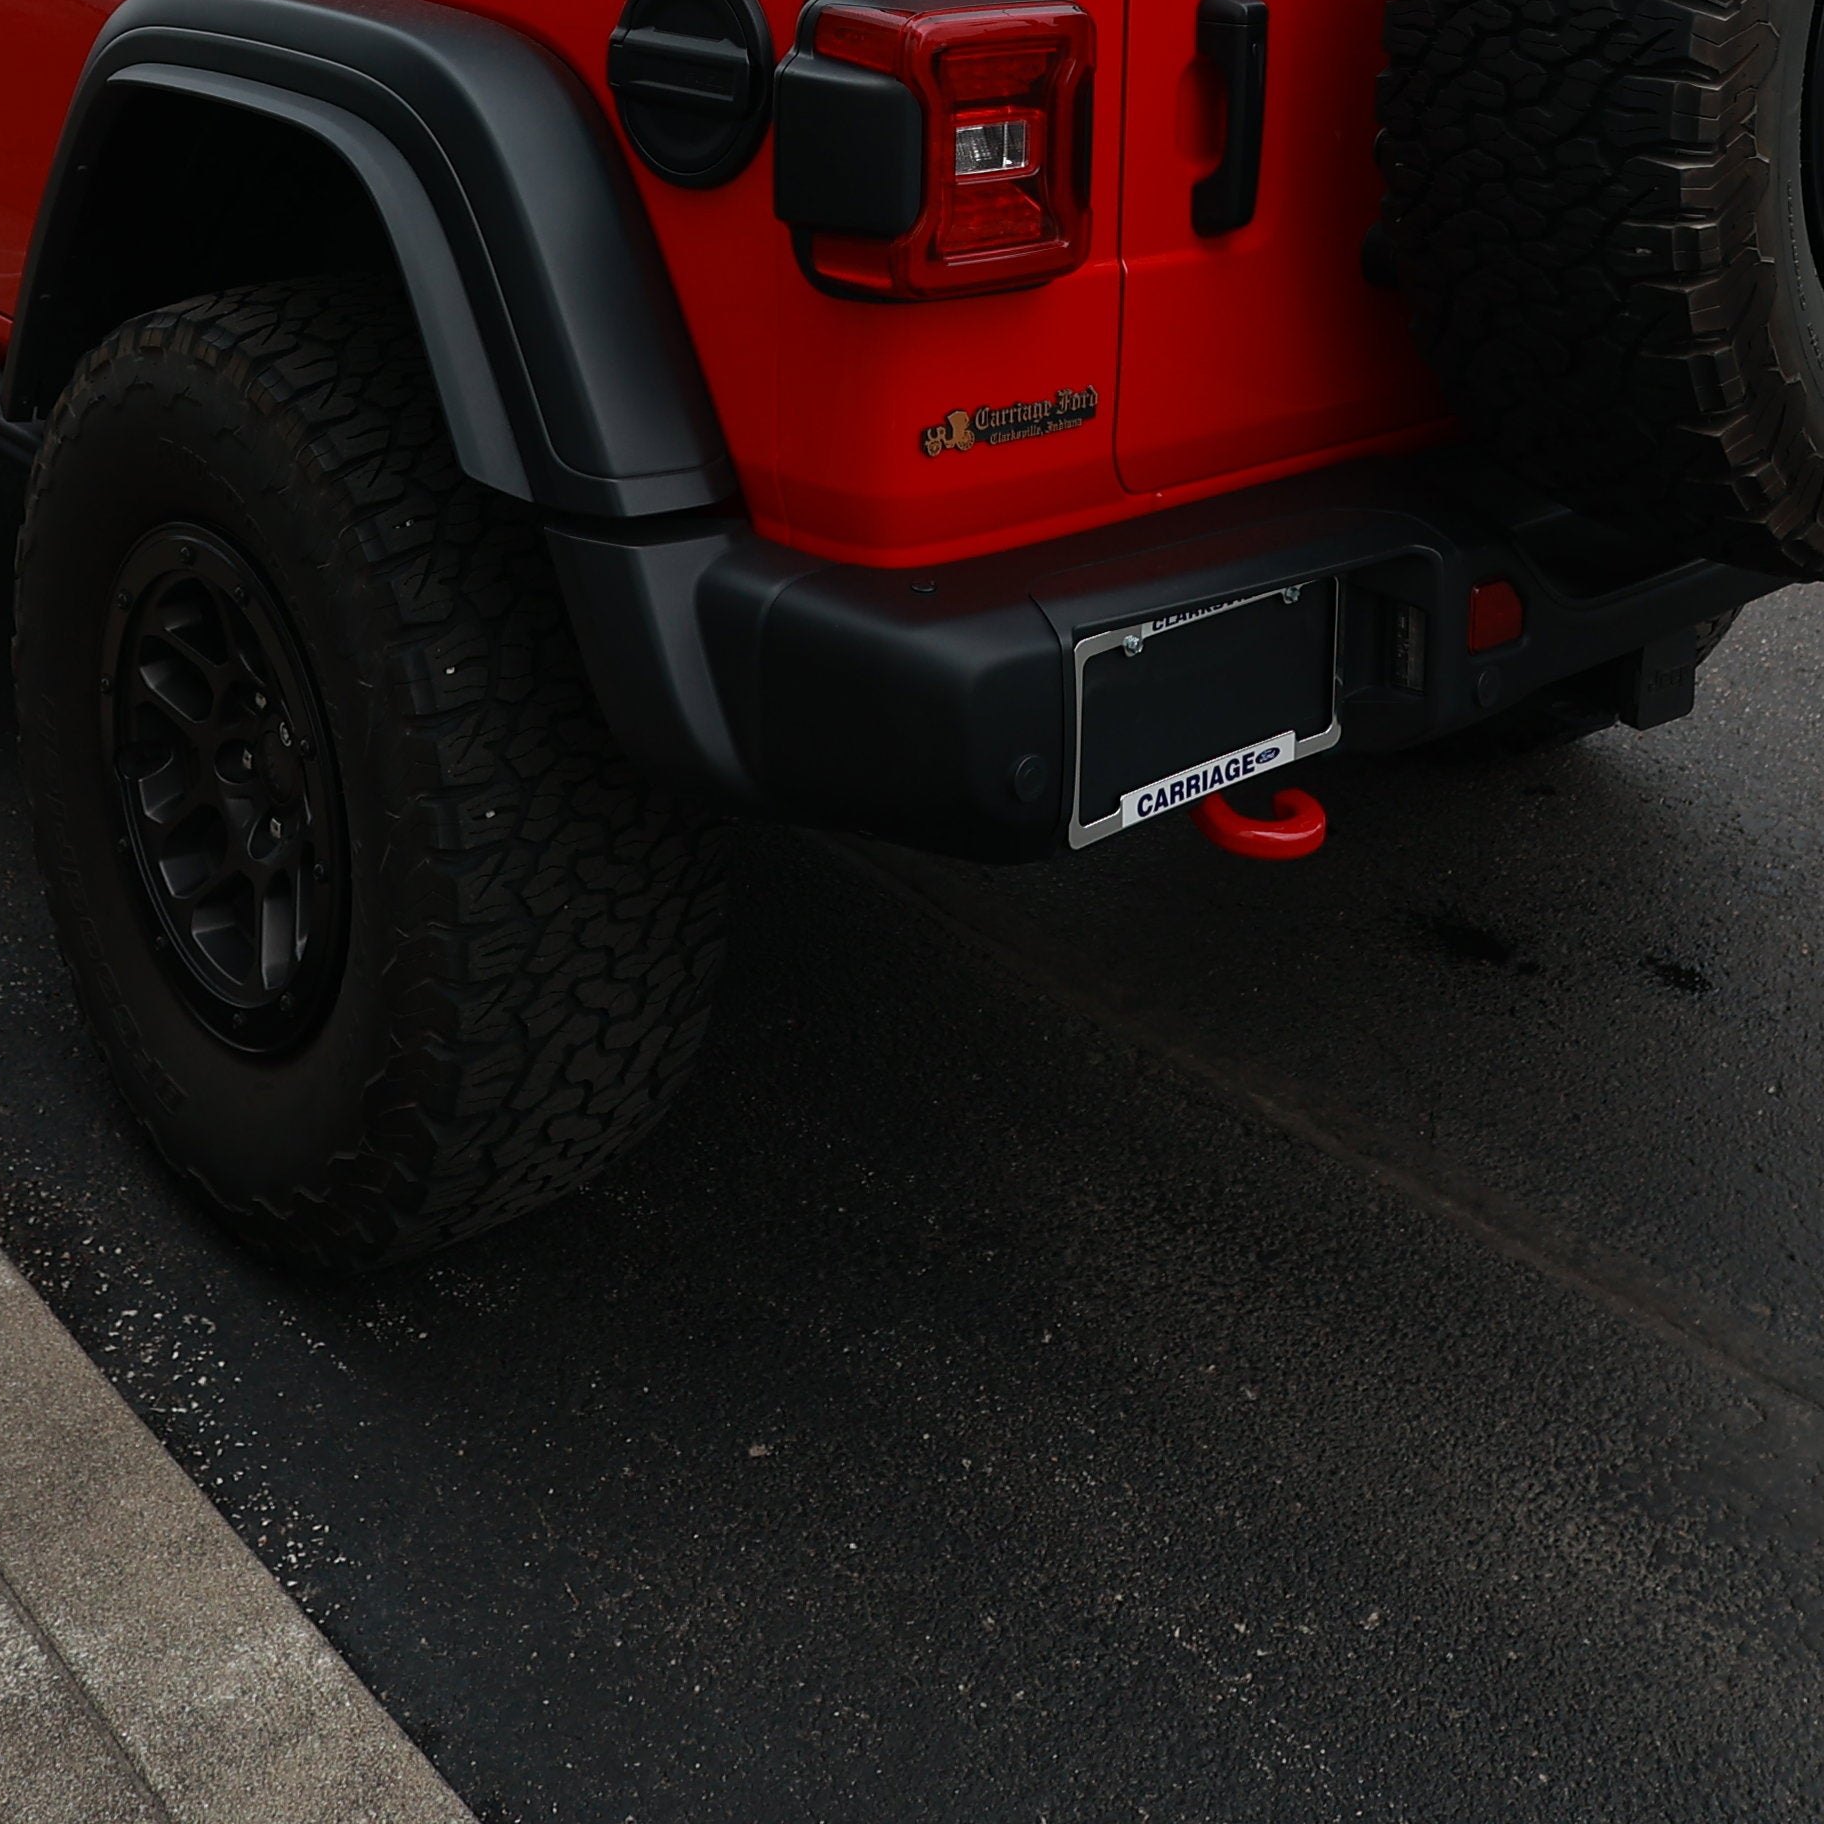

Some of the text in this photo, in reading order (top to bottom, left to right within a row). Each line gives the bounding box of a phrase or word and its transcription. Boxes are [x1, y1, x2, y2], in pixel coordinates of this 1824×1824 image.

[975, 384, 1098, 430] Carriage Ford
[1046, 418, 1082, 433] Indiana
[1137, 752, 1255, 817] CARRIAGE
